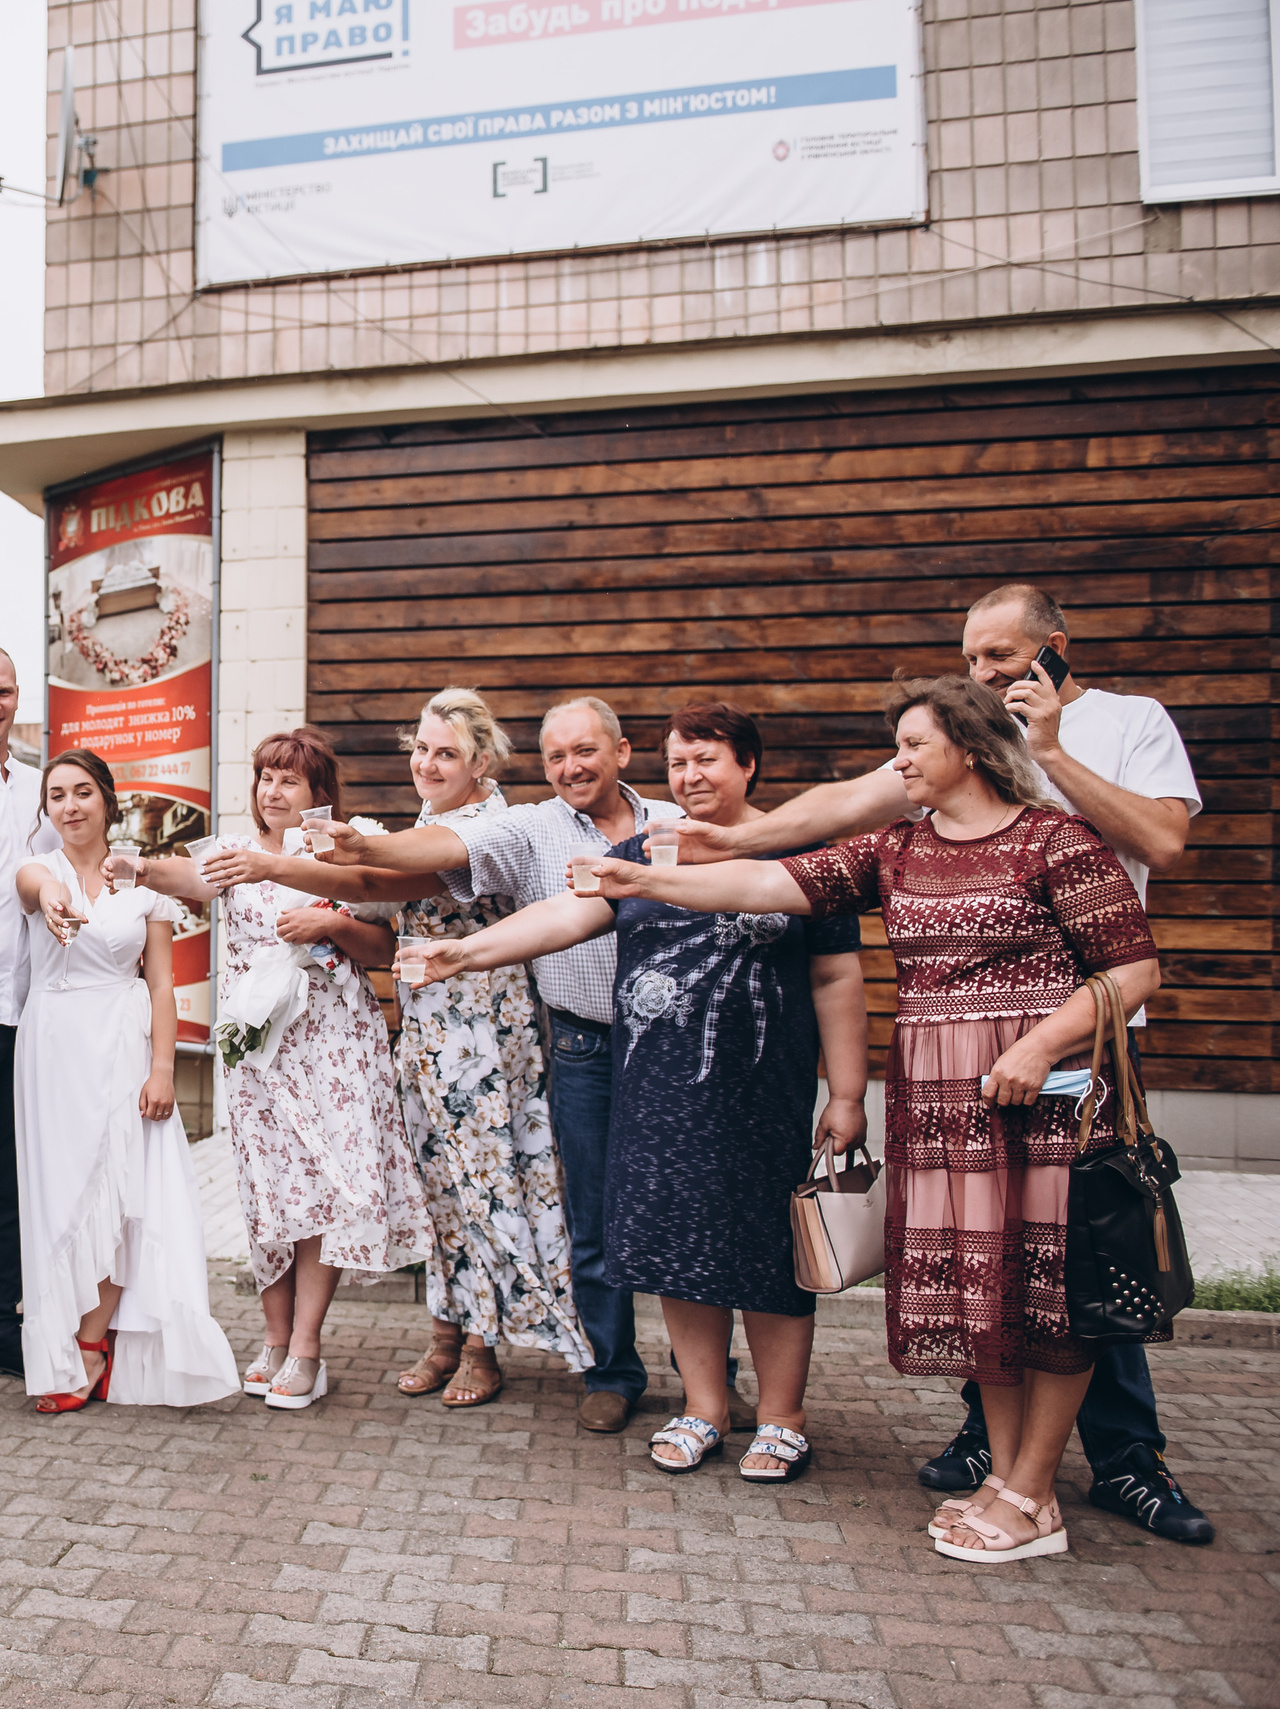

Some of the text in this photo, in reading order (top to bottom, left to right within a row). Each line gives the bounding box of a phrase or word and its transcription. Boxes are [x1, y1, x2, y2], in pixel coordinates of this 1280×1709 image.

[275, 0, 392, 25] Я МАЮ
[465, 0, 665, 38] Забудь про
[323, 123, 423, 155] ЗАХИЩАЙ
[427, 116, 474, 142] СВОЇ
[478, 112, 546, 136] ПРАВА
[550, 103, 621, 129] РАЗОМ
[625, 101, 639, 119] З
[90, 481, 205, 534] ПІДКОВА
[81, 716, 124, 732] молодят
[128, 711, 170, 727] знижка
[172, 705, 196, 722] 10%
[80, 734, 134, 751] подарунок
[136, 732, 142, 746] у
[144, 727, 182, 743] номер
